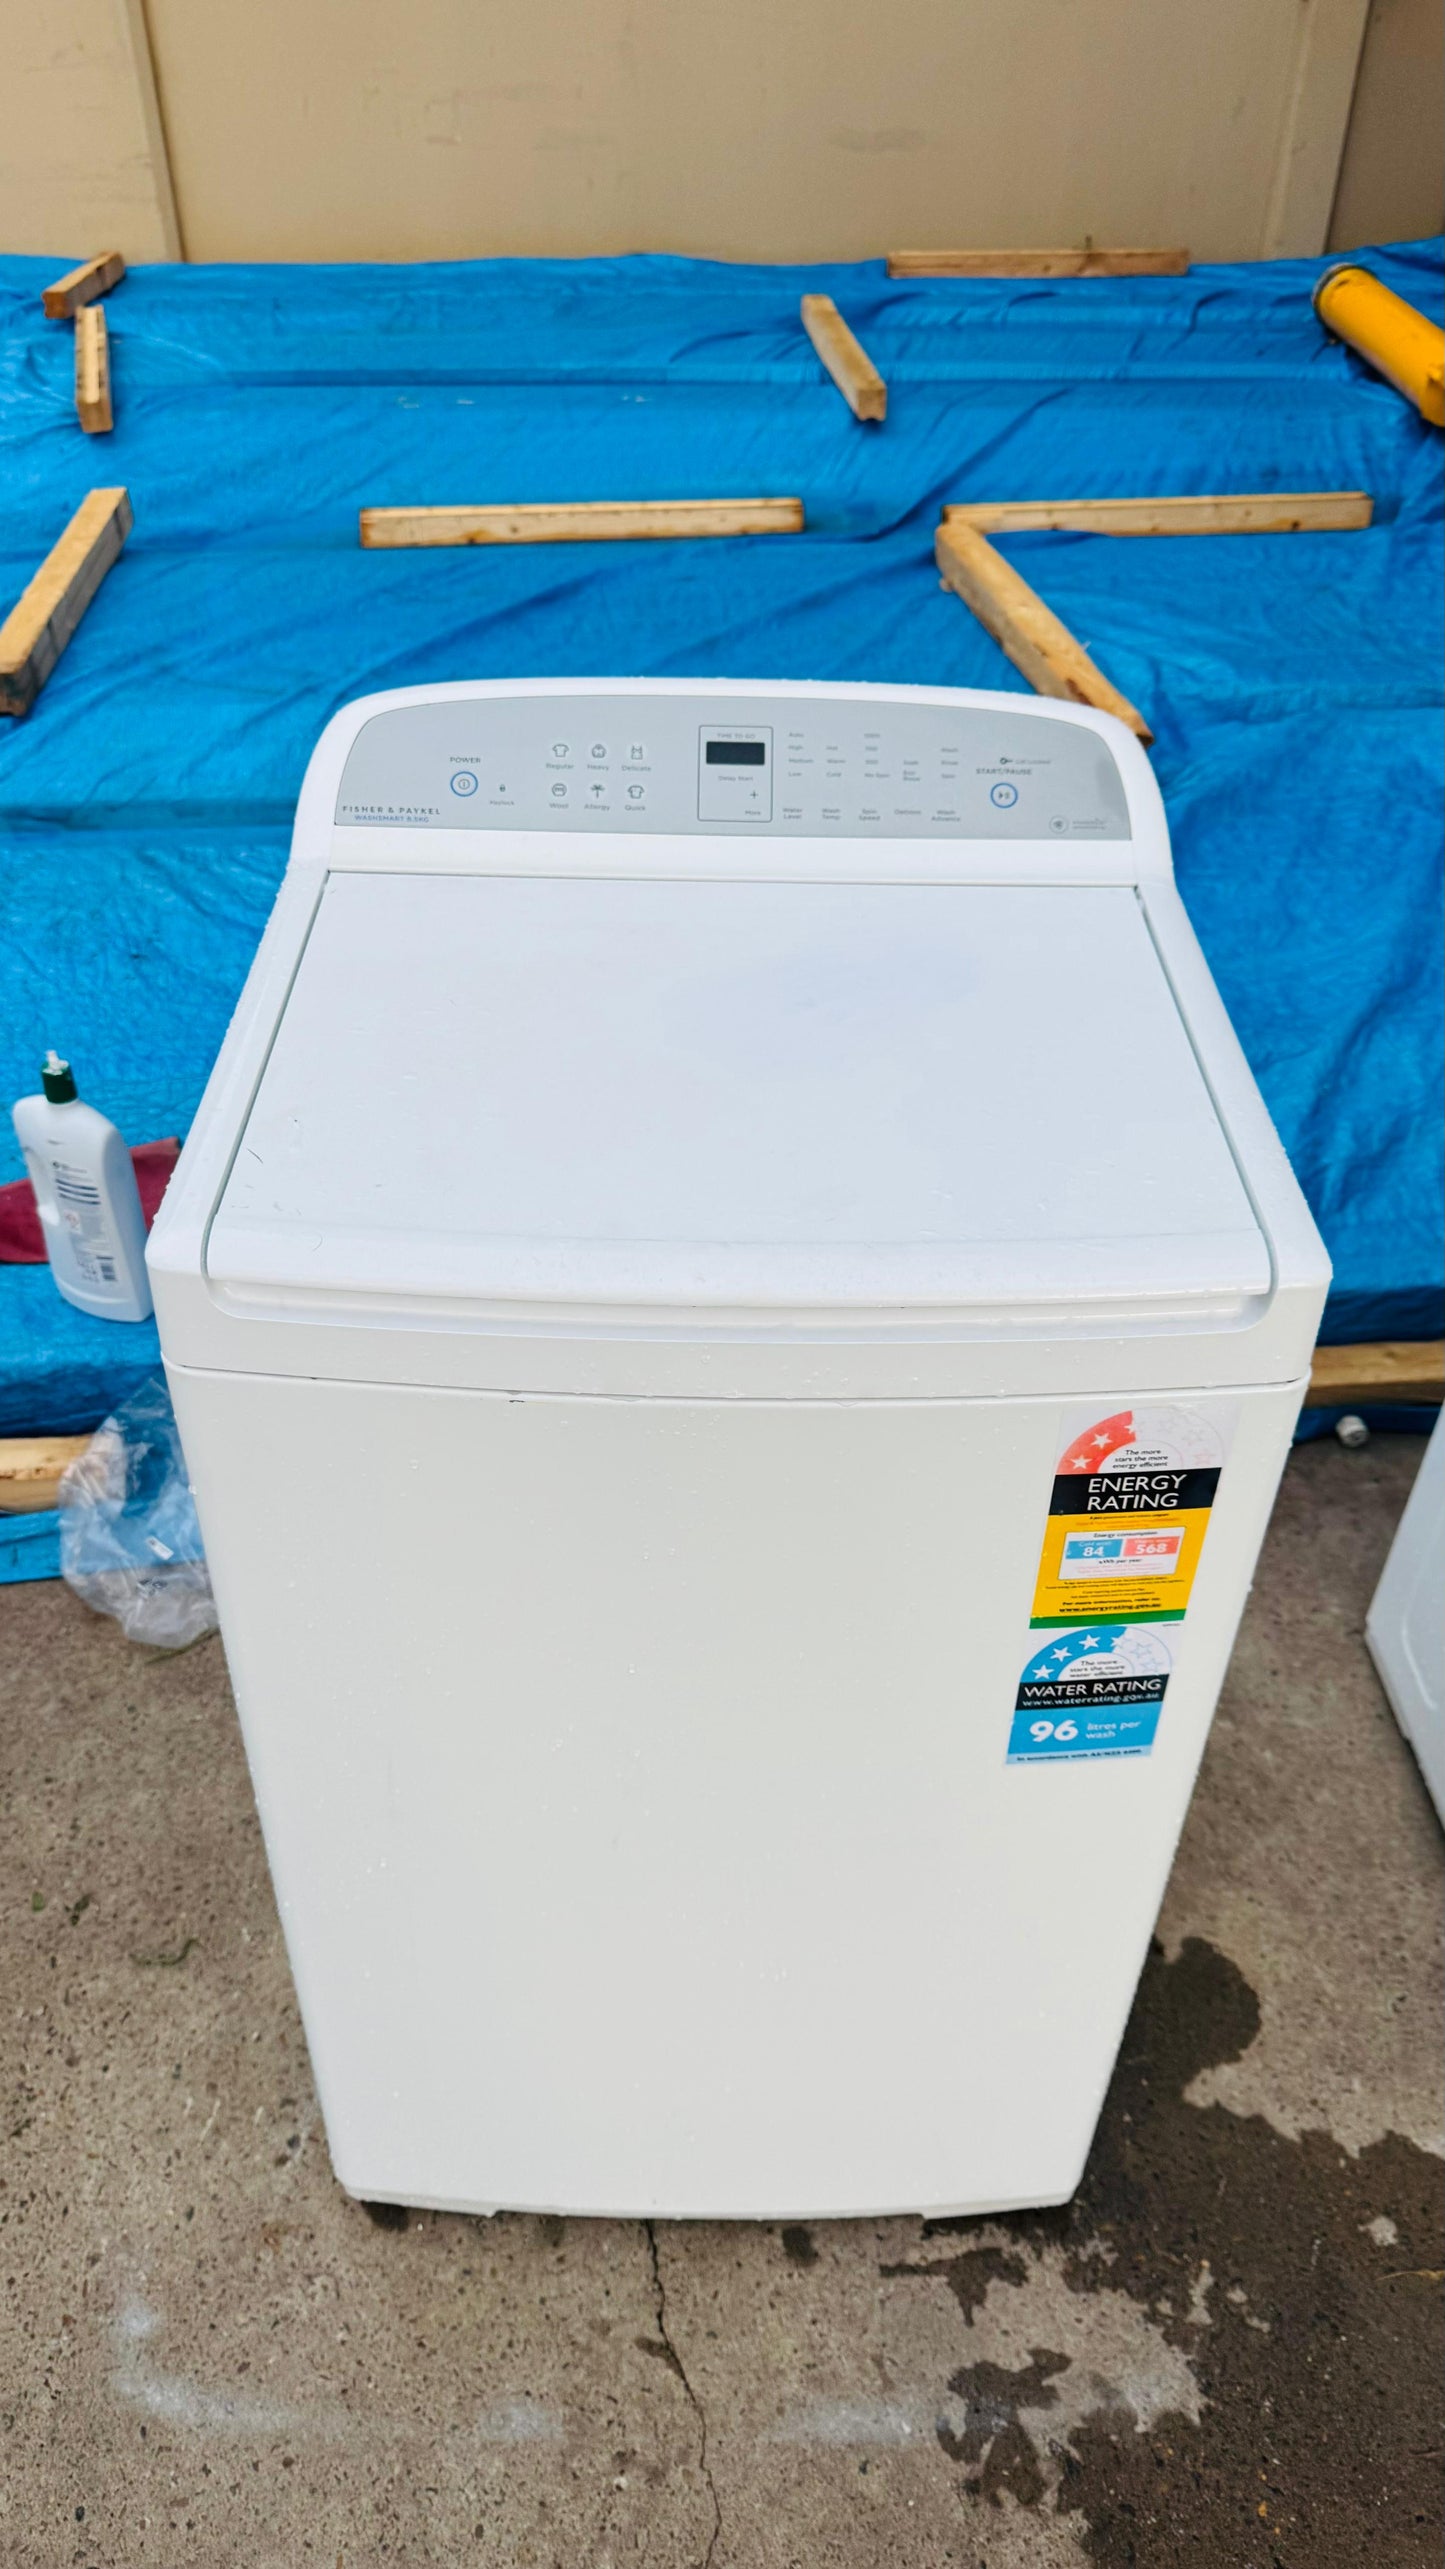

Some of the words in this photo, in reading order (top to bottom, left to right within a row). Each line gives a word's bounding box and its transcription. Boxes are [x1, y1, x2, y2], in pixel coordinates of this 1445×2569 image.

[449, 756, 481, 764] POWER
[342, 805, 383, 813] FISHER
[388, 806, 395, 814] &
[399, 807, 441, 815] PAYKEL
[584, 803, 610, 812] Allergy
[1088, 1474, 1187, 1493] ENERGY
[1087, 1493, 1179, 1511] RATING
[1082, 1546, 1105, 1557] 84
[1135, 1543, 1167, 1554] 568
[1024, 1684, 1087, 1697] WATER
[1093, 1678, 1161, 1693] RATING
[1022, 1693, 1160, 1707] www.waterrating.gov.au
[1029, 1719, 1079, 1742] 96
[1087, 1721, 1117, 1731] litres
[1120, 1721, 1142, 1731] per
[1085, 1730, 1117, 1740] wash
